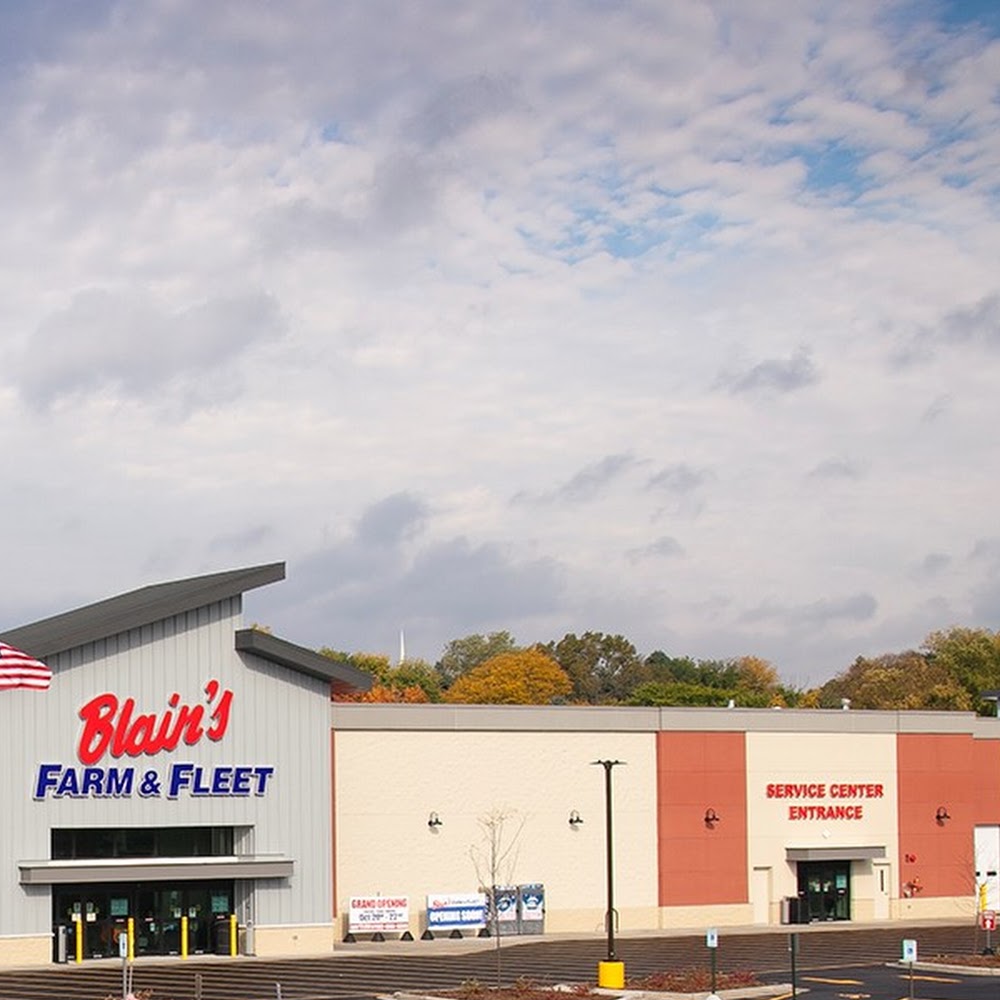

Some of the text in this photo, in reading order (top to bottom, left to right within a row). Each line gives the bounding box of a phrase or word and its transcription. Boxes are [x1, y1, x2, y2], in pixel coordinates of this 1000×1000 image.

[78, 679, 234, 766] Blain's
[34, 763, 275, 799] FARM & FLEET
[766, 783, 884, 799] SERVICE CENTER
[788, 805, 863, 820] ENTRANCE
[351, 898, 407, 909] GRAND OPENING
